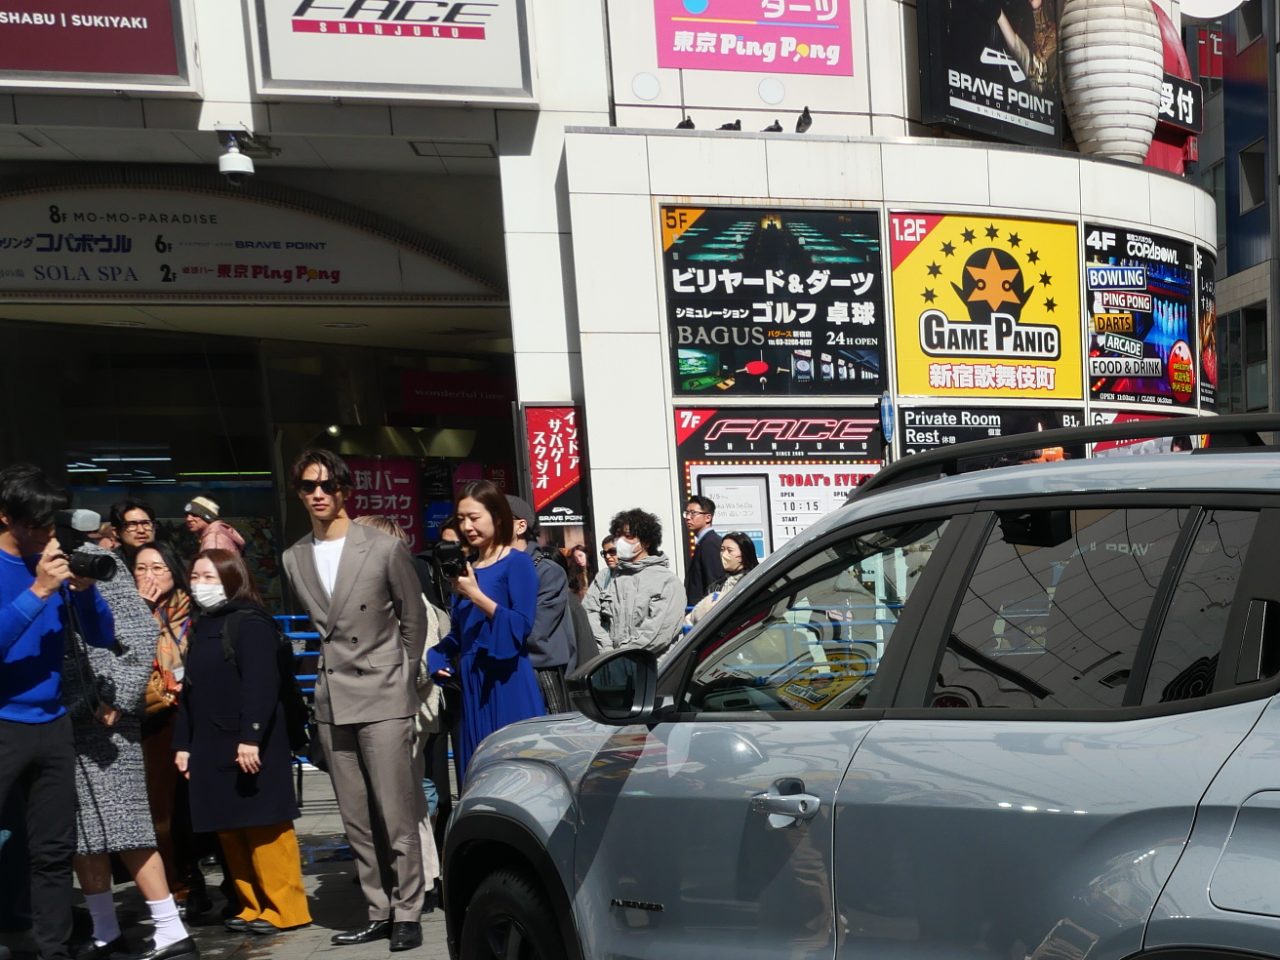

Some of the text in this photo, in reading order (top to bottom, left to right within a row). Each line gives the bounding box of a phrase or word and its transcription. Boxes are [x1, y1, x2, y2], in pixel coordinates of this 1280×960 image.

[0, 12, 148, 29] SHABU SUKIYAKI
[292, 0, 499, 24] FACE
[320, 21, 459, 38] SHINJUKU
[672, 31, 717, 53] 東京
[720, 33, 777, 63] Ping
[948, 69, 1055, 116] BRAVE POINT
[976, 106, 1030, 126] SHINJUKU
[49, 205, 218, 225] 8F MO-MO-PARADISE
[665, 208, 688, 229] 5F
[0, 236, 34, 250] リング
[235, 240, 281, 250] BRAVE
[285, 241, 328, 251] POINT
[1086, 231, 1116, 250] 4F
[33, 265, 92, 282] SOLA
[98, 266, 139, 283] SPA
[251, 264, 293, 284] Ping
[1090, 269, 1144, 286] BOWLING
[1103, 293, 1150, 310] PING PONG
[676, 301, 875, 325] シミュレーション ゴルフ 卓球
[1097, 316, 1131, 331] DARTS
[677, 326, 765, 346] BAGUS
[826, 331, 845, 346] 24
[854, 337, 878, 346] OPEN
[923, 313, 1056, 353] GAME PANIC
[1107, 335, 1141, 356] ARCADE
[928, 363, 1056, 390] 新宿歌舞伎町
[1092, 360, 1161, 375] FOOD & DRINK
[680, 411, 701, 428] 7F
[904, 411, 1001, 426] Private Room
[704, 418, 880, 440] FACE
[906, 429, 940, 443] Rest
[564, 411, 581, 470] インドア
[704, 442, 868, 450] SHINJUKU
[533, 431, 550, 490] スタジオ
[354, 494, 412, 511] カラオケ
[782, 501, 819, 512] 10:15
